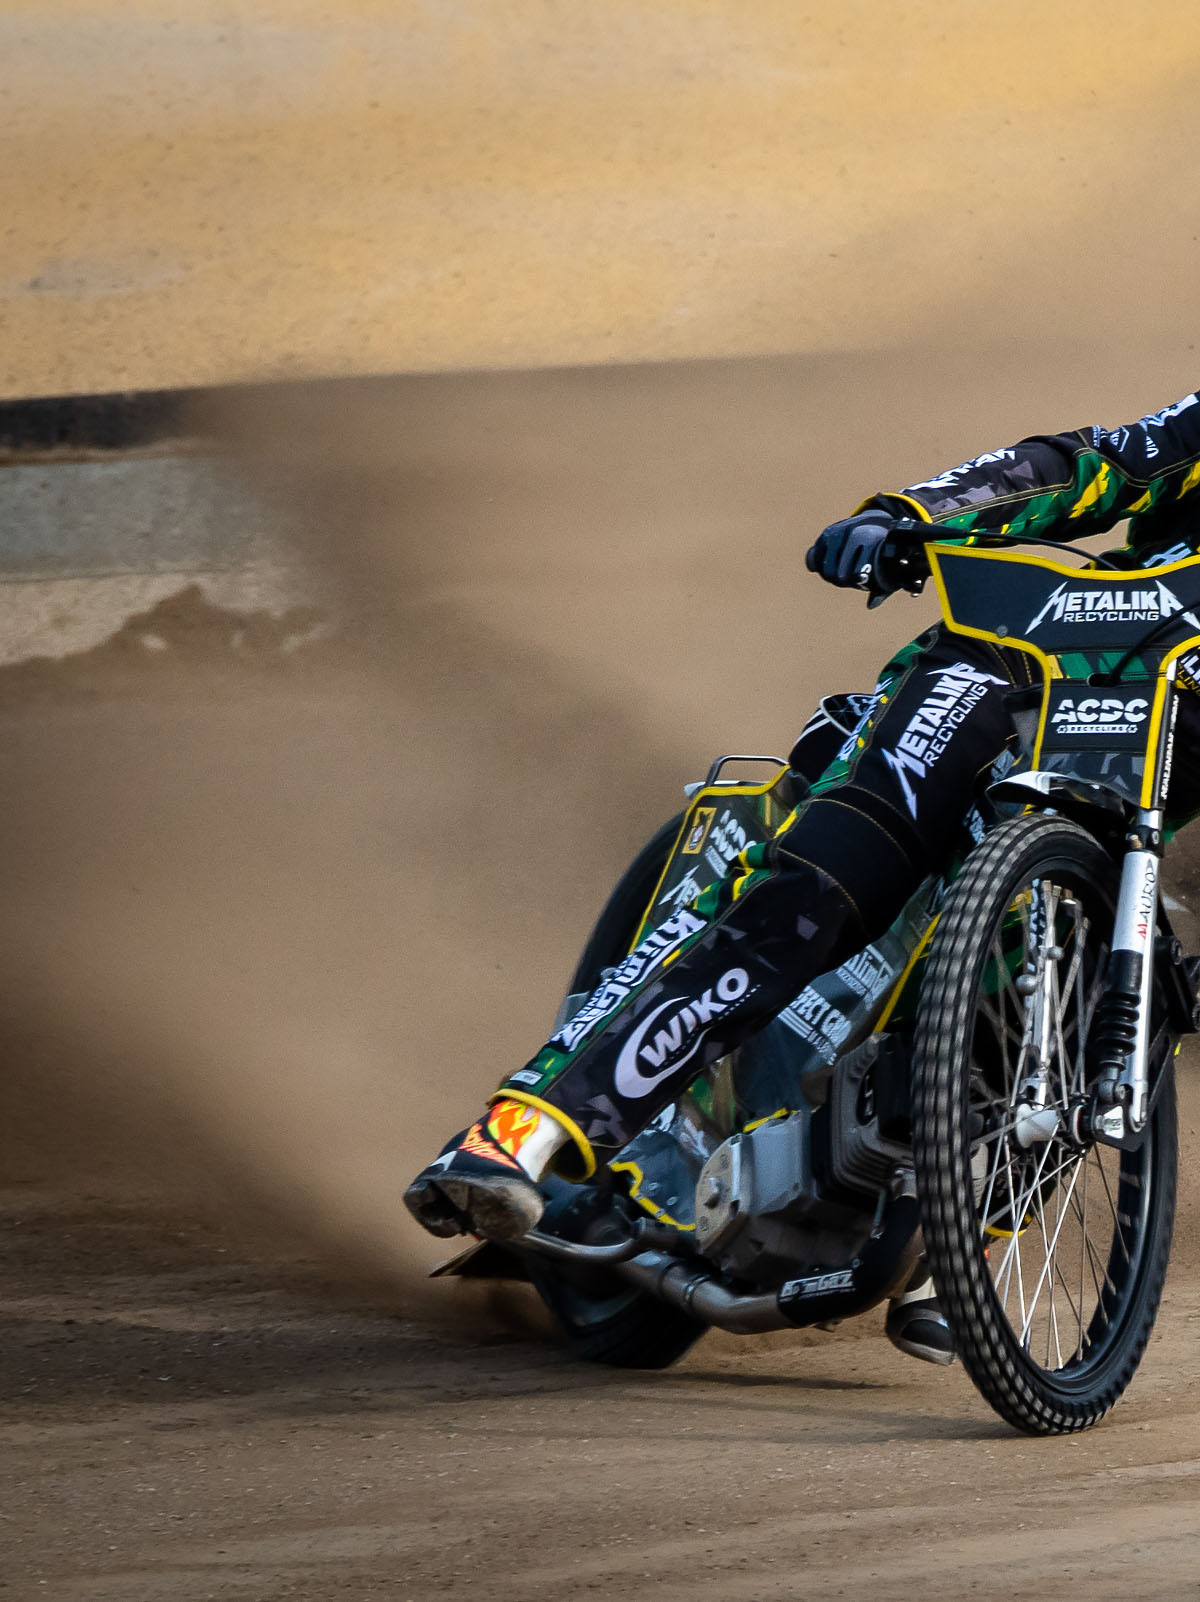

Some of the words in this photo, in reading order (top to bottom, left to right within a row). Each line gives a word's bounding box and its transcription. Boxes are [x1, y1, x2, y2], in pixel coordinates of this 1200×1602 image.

[1063, 610, 1160, 623] RECYCLING
[922, 683, 989, 767] RECYCLING
[1051, 698, 1149, 723] ACDC
[1068, 725, 1126, 733] RECYCLING
[881, 662, 1010, 820] METALIKA
[639, 967, 750, 1068] WIKO
